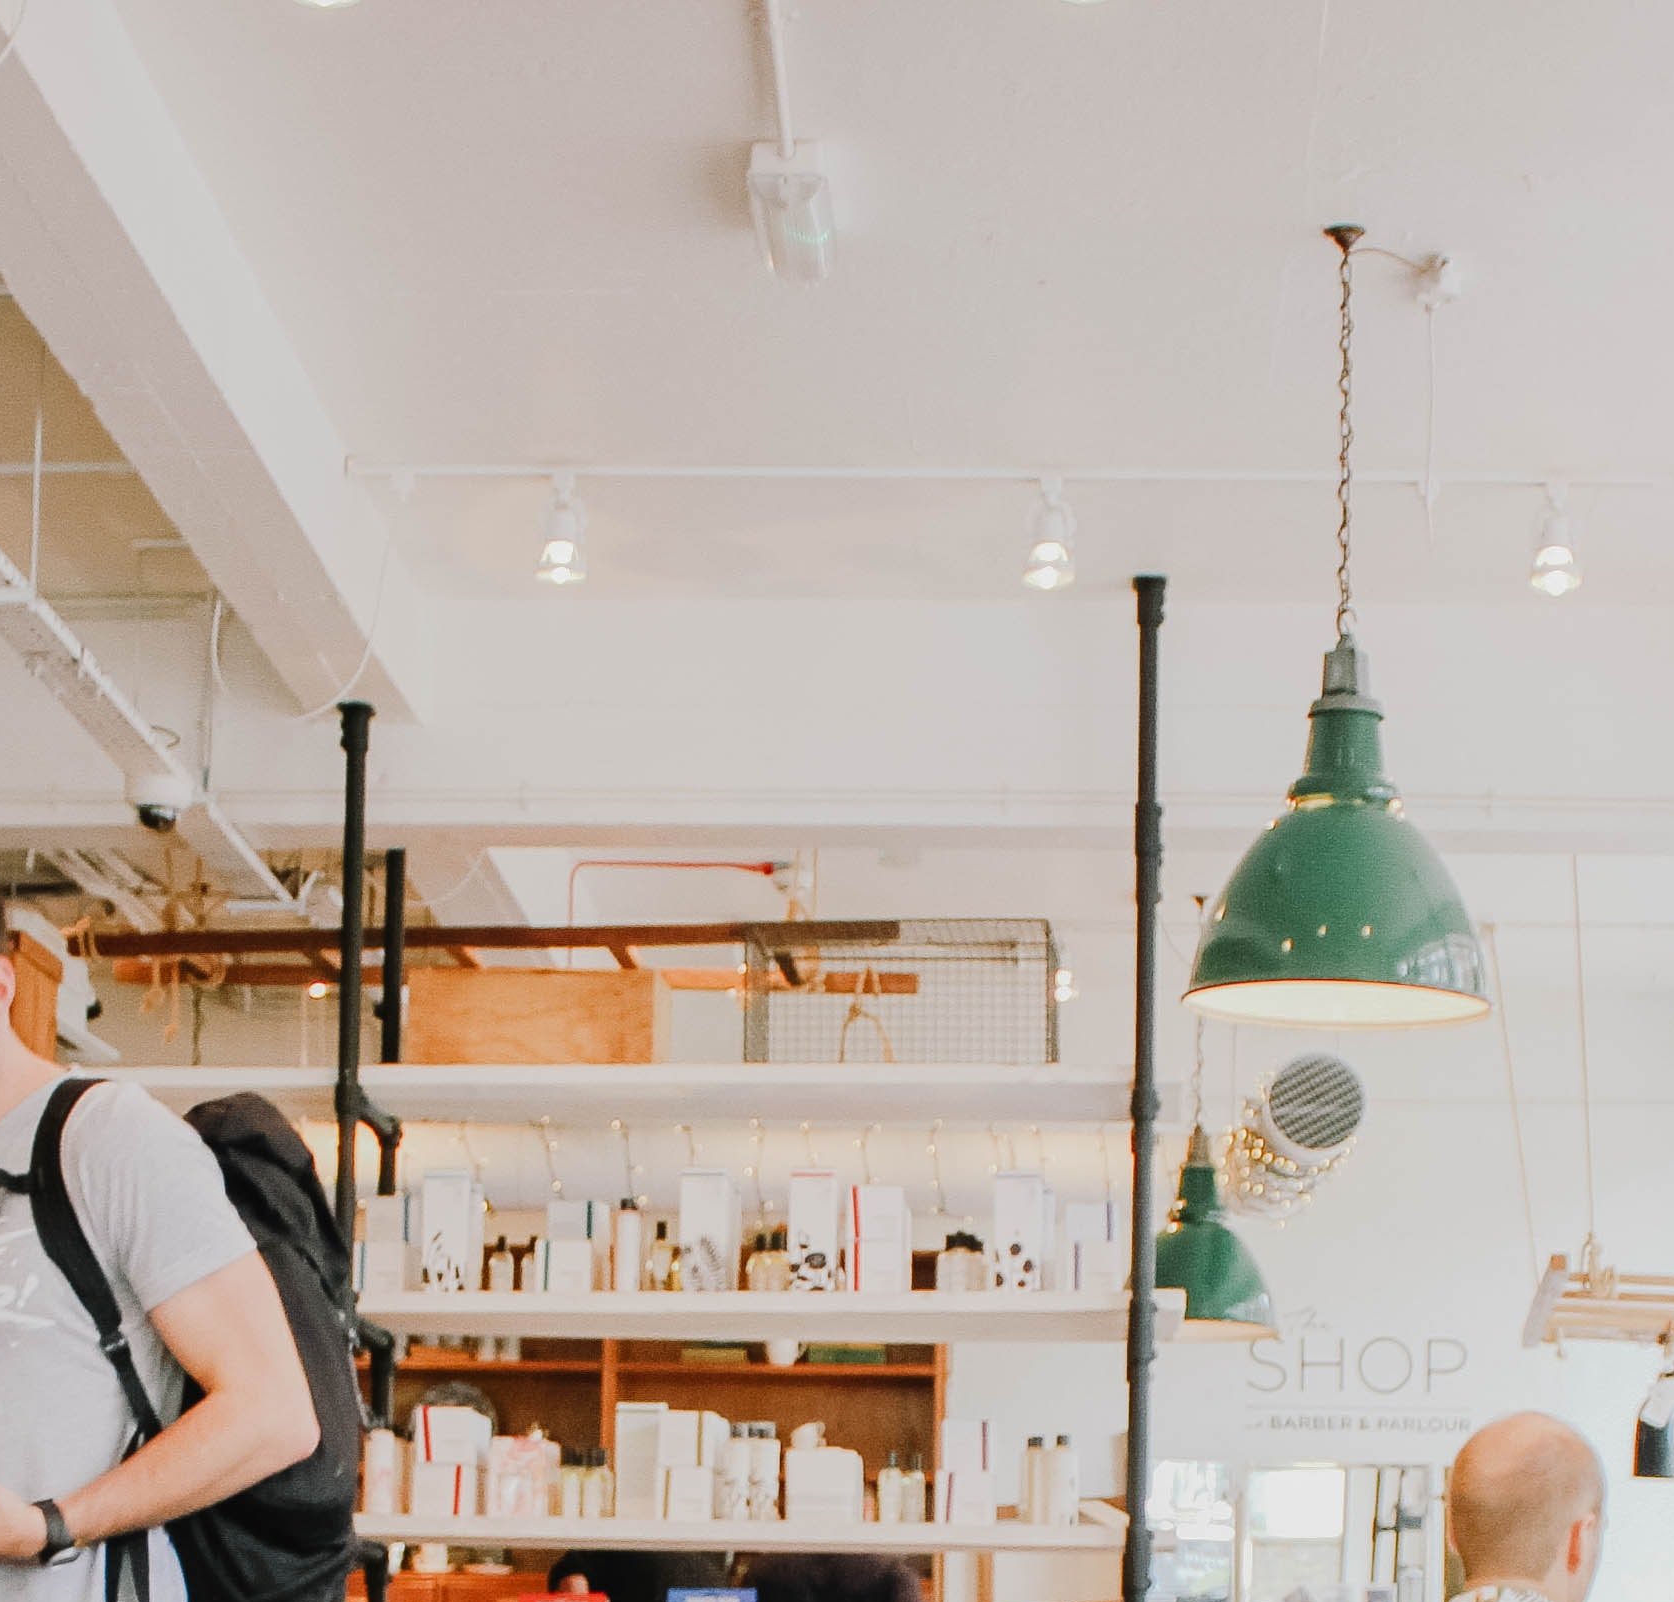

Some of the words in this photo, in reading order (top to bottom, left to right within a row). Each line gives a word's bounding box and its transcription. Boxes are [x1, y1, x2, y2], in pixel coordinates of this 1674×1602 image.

[1246, 1336, 1468, 1394] SHOP
[1269, 1414, 1353, 1431] BARBER
[1376, 1415, 1472, 1432] PARLOUR
